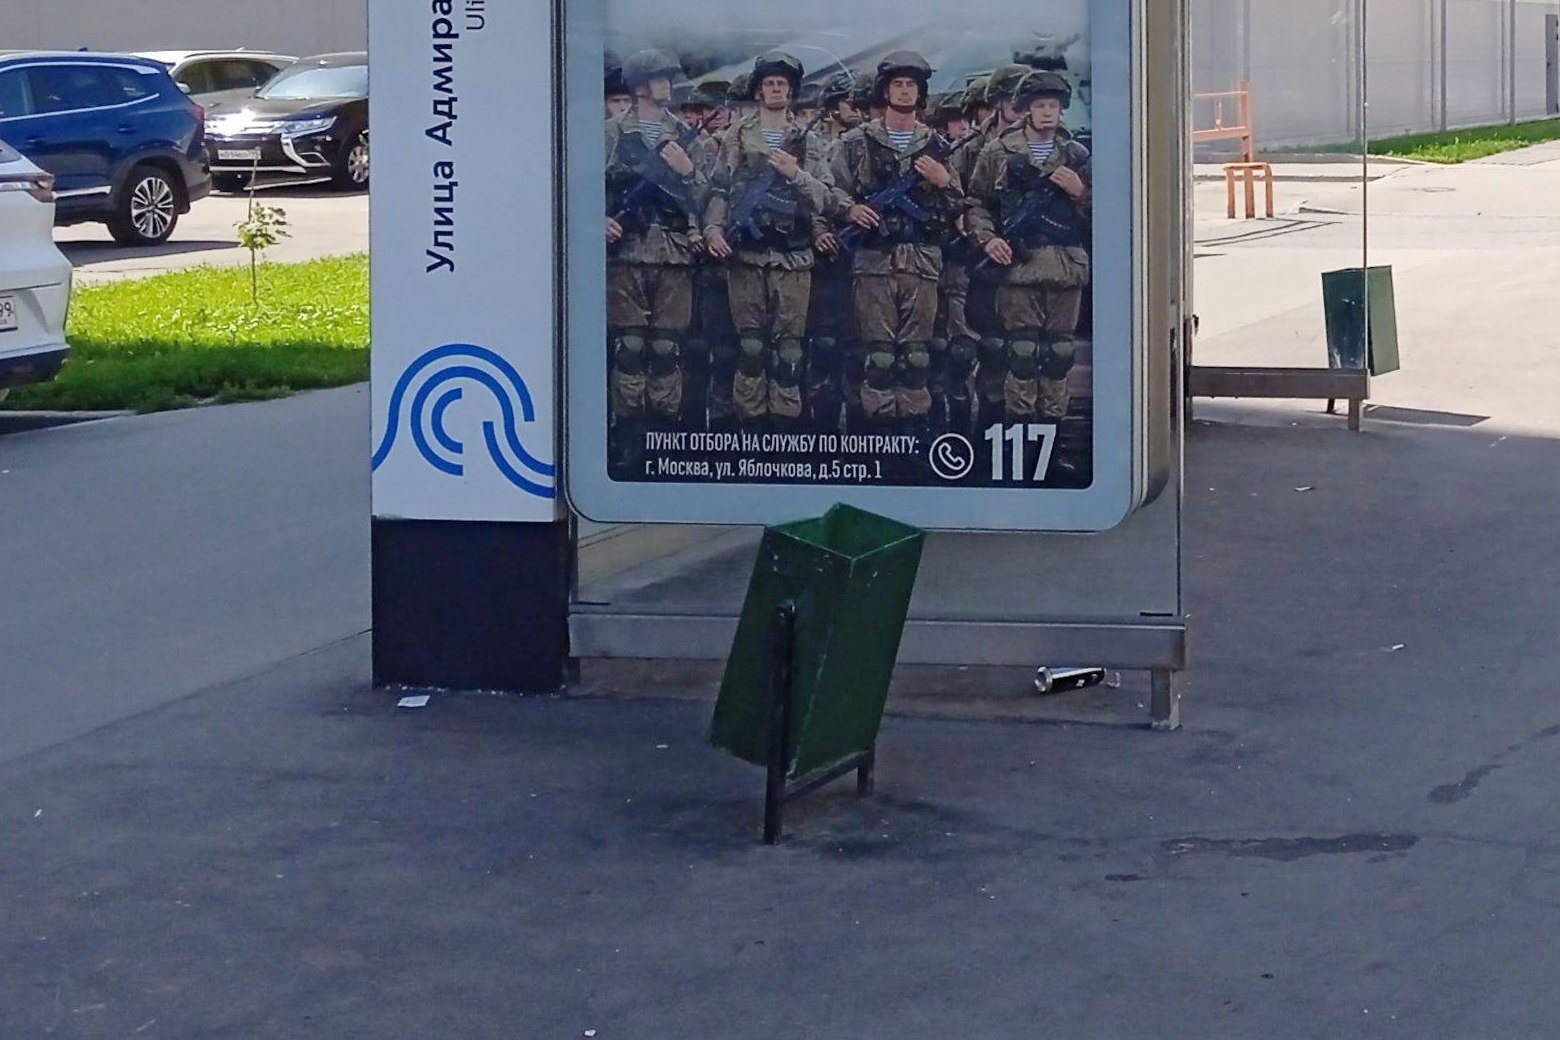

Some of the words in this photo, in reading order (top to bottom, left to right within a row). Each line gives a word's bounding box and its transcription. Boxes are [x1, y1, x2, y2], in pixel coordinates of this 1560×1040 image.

[425, 160, 459, 273] Улица
[645, 432, 688, 453] ПУНКТ
[689, 433, 740, 453] ОТБОРА
[741, 434, 761, 453] НА
[762, 434, 816, 454] СЛУЖБУ
[818, 435, 838, 454] ПО
[840, 435, 920, 455] КОНТРАКТУ:
[984, 423, 1057, 482] 117
[645, 463, 655, 476] г.
[657, 459, 714, 479] Москва,
[715, 463, 735, 480] ул.
[738, 461, 818, 480] Яблочкова,
[842, 465, 871, 482] стр.
[874, 461, 882, 478] 1
